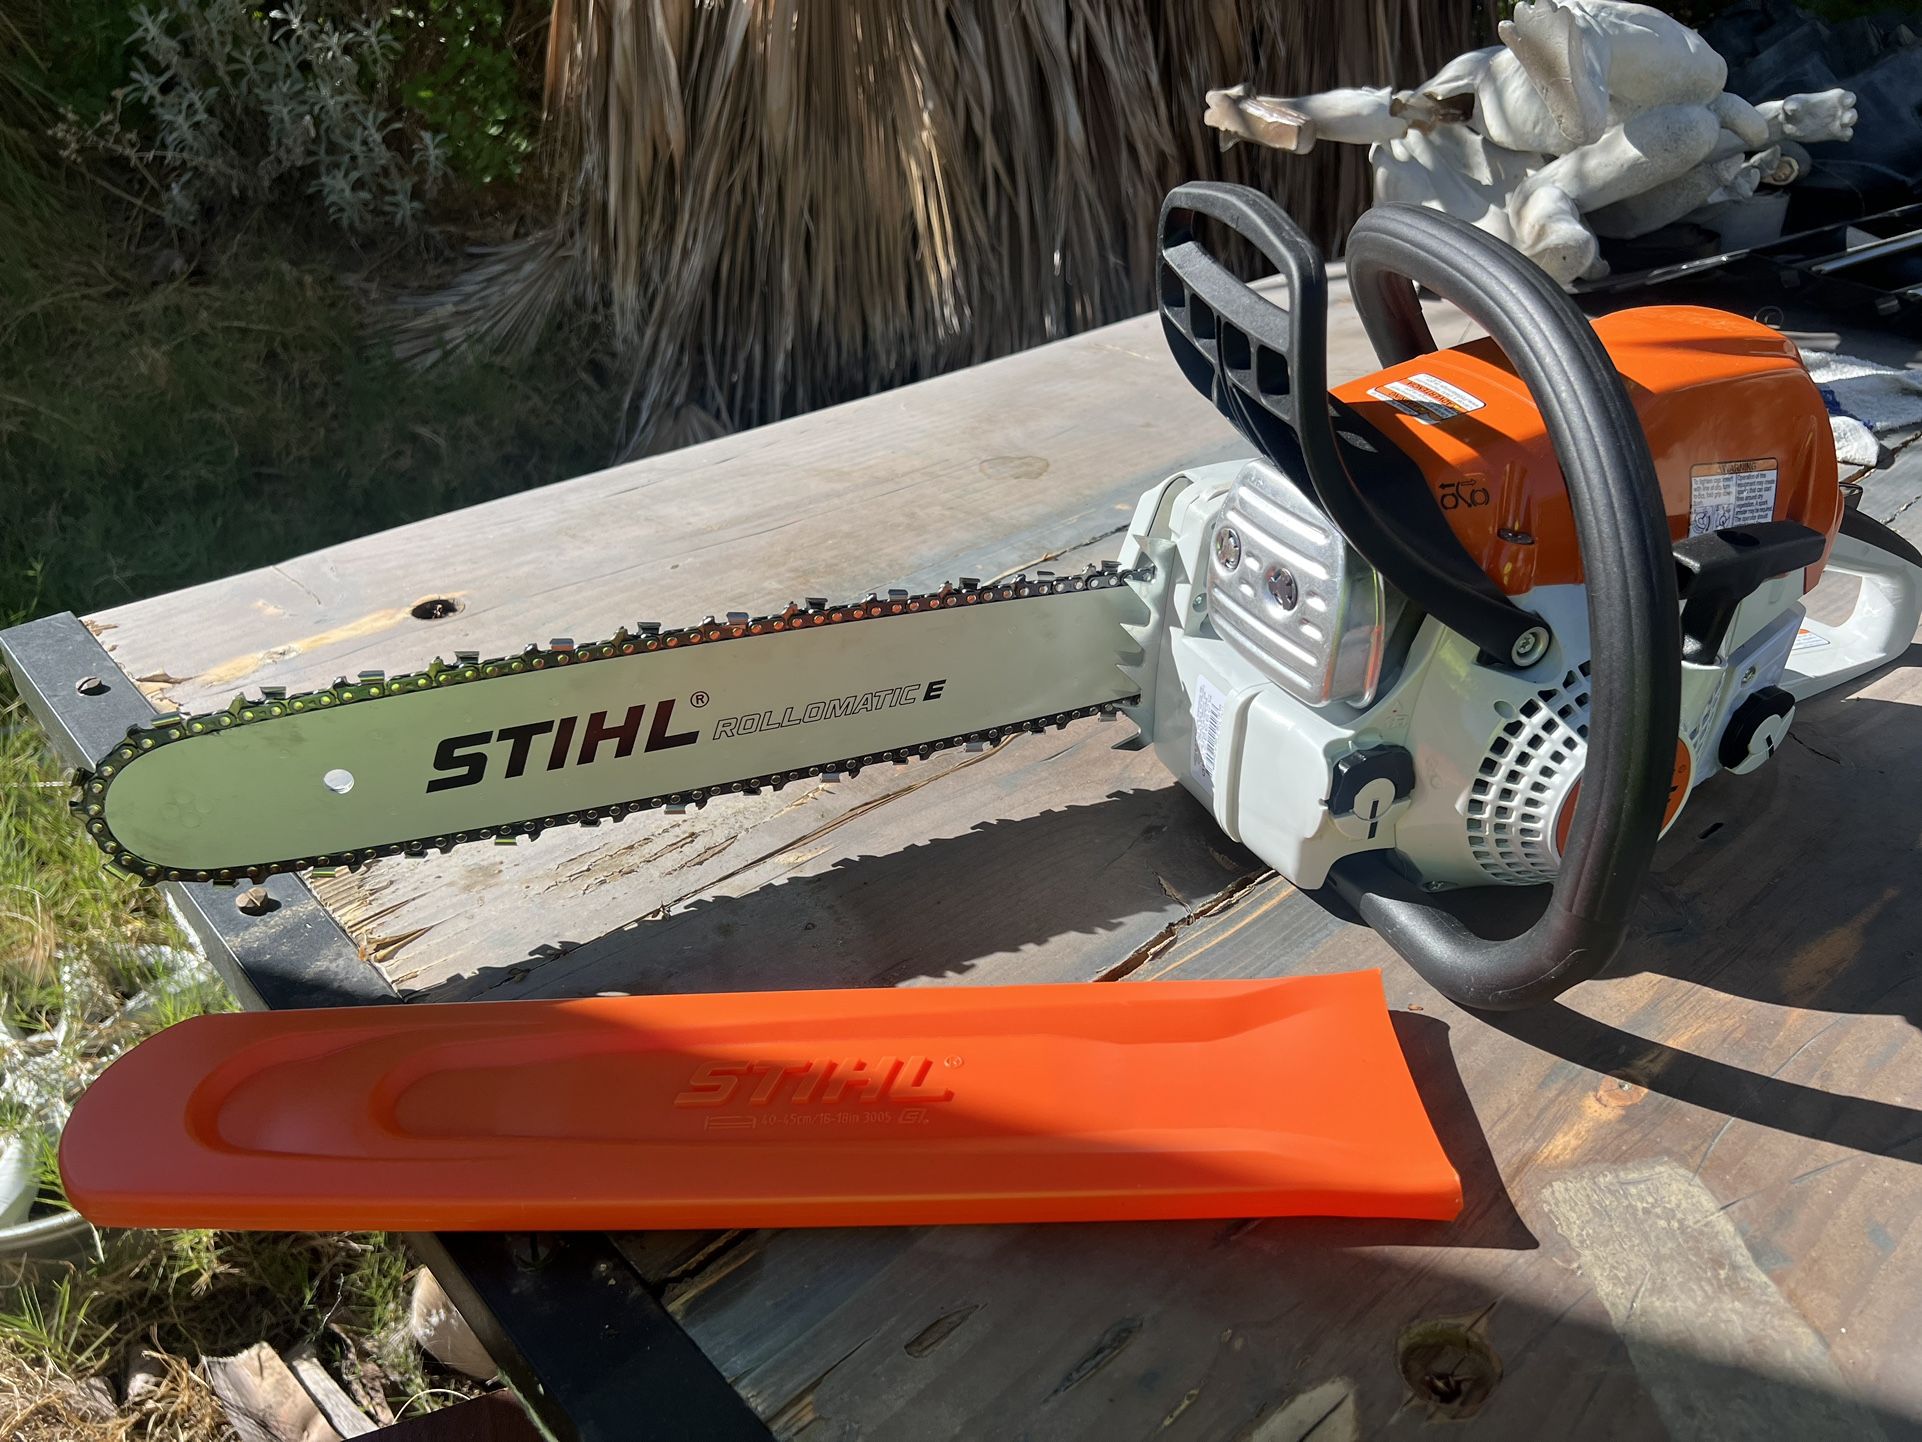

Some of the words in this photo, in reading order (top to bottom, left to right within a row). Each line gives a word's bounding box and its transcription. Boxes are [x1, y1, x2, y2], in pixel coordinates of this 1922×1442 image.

[712, 684, 920, 740] ROLLOMATIC
[923, 680, 946, 702] E
[426, 698, 700, 794] STIHL
[674, 1056, 955, 1108] STIHL
[863, 1110, 892, 1124] 3005
